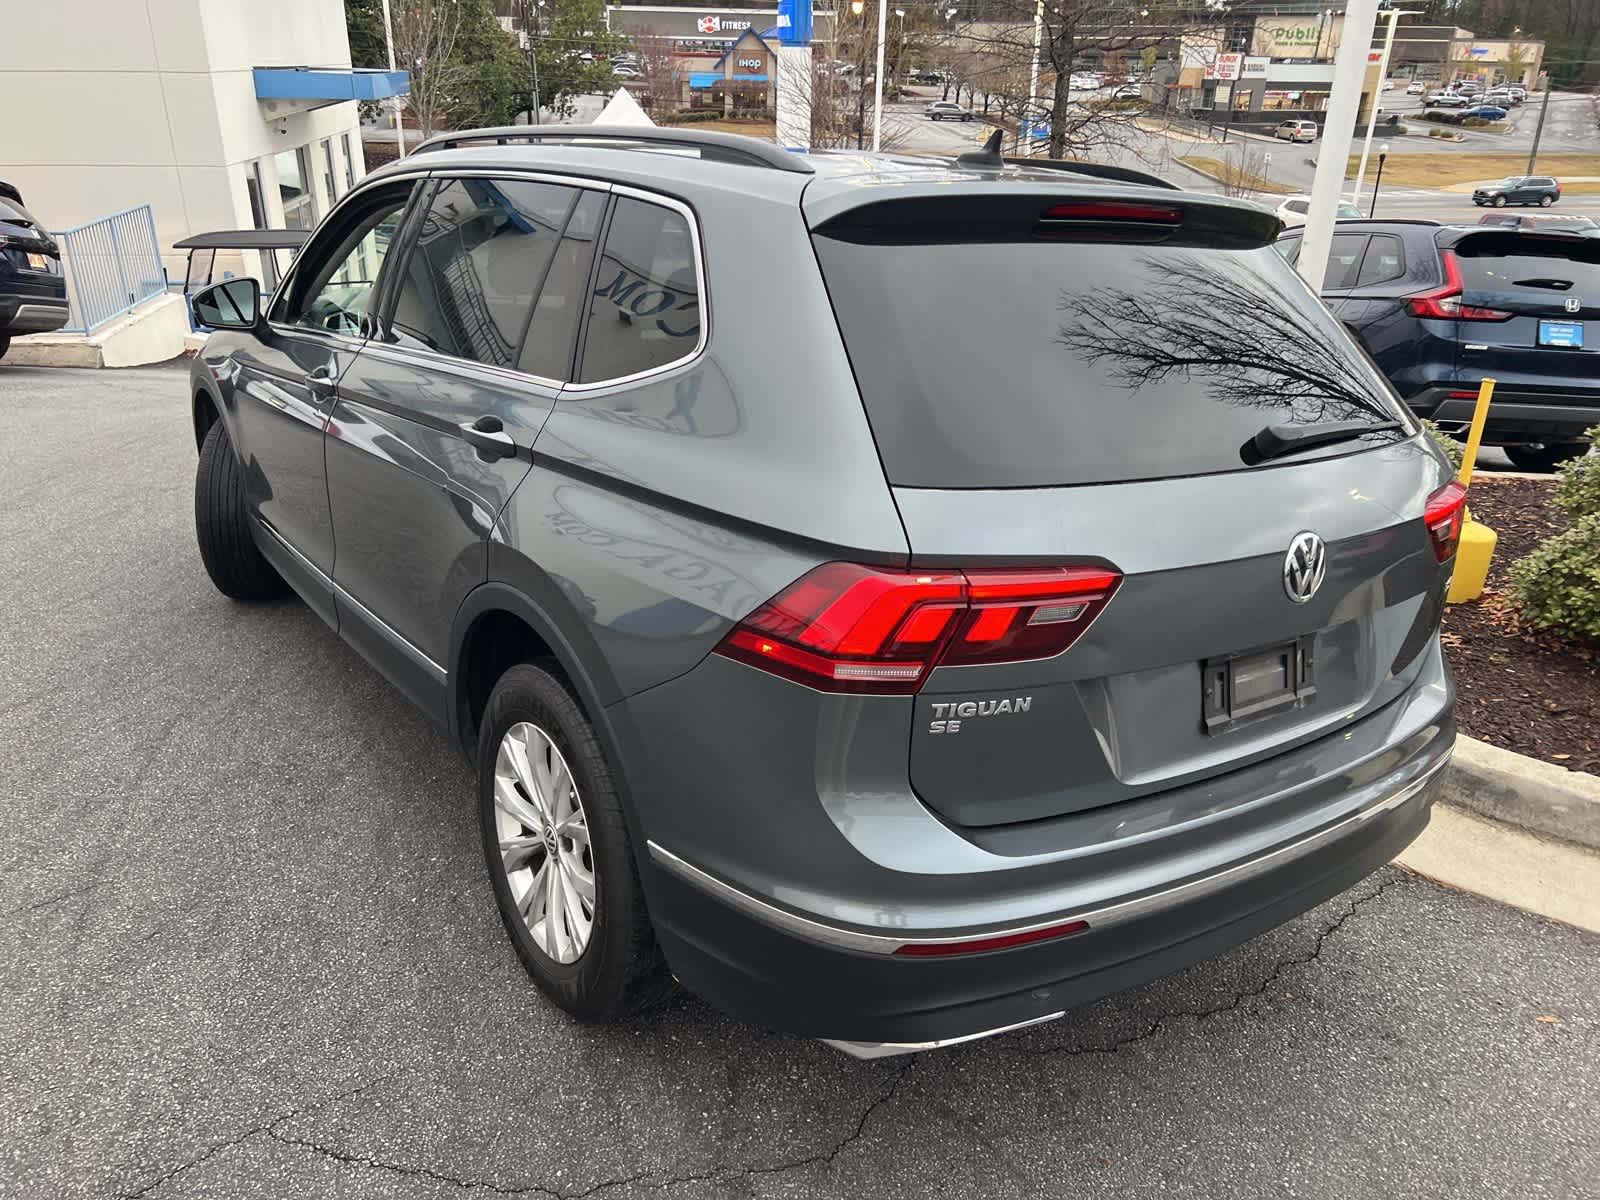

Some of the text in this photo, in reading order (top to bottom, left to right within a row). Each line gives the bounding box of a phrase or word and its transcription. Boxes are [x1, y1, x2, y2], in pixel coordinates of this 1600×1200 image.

[721, 21, 752, 30] FITNESS
[1275, 27, 1321, 40] Publi
[931, 697, 1032, 718] TIGUAN
[928, 720, 962, 734] SE
